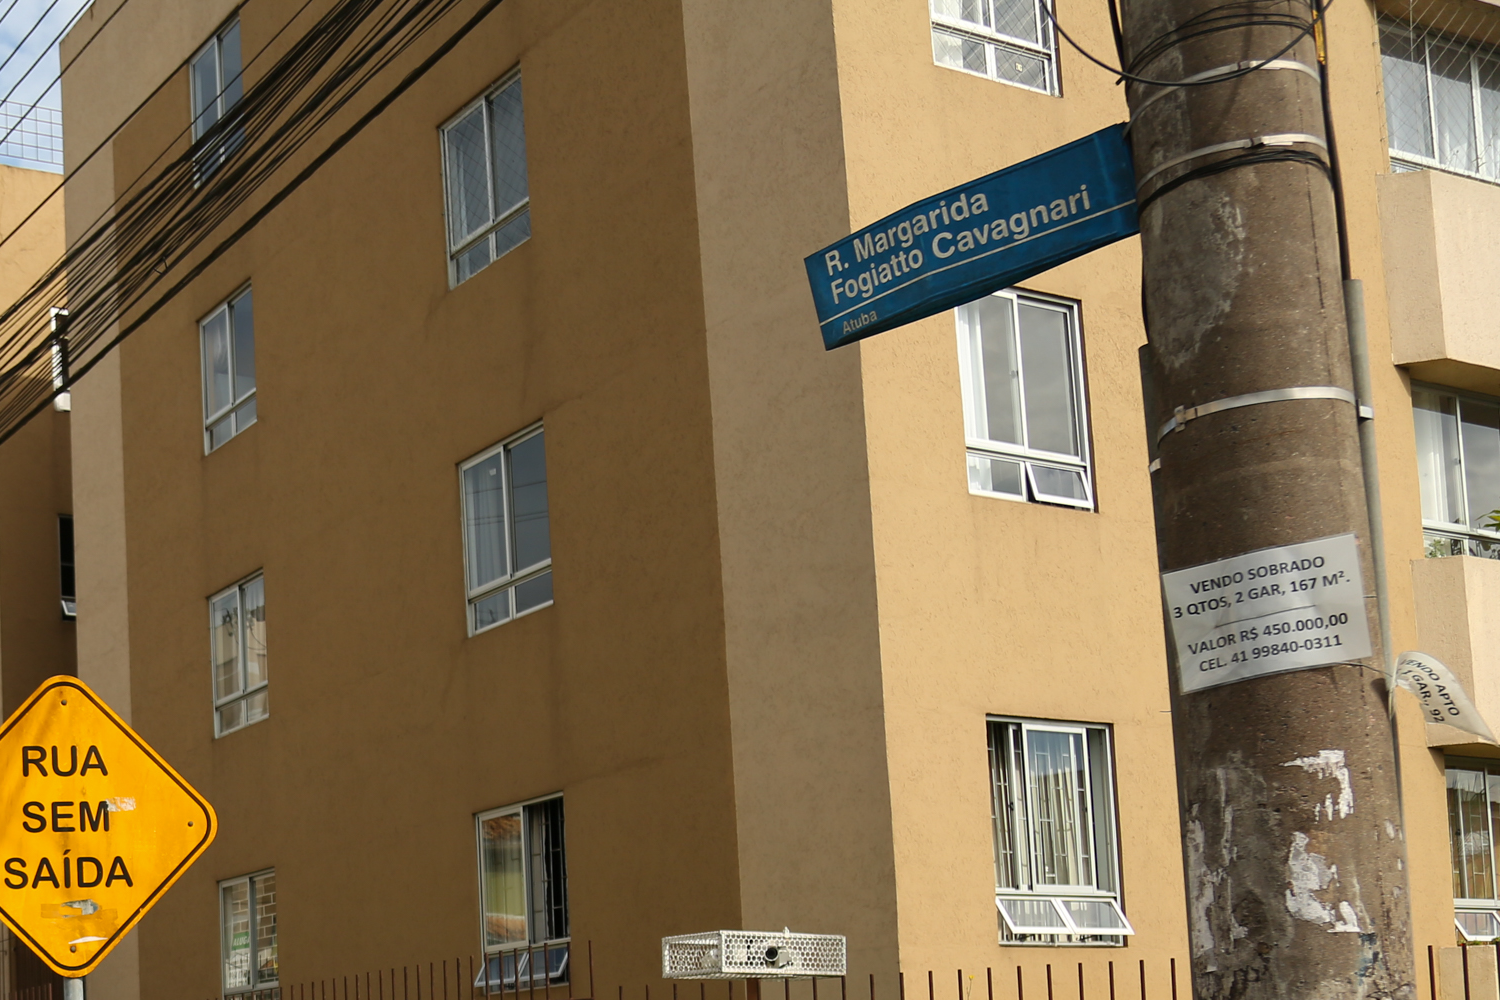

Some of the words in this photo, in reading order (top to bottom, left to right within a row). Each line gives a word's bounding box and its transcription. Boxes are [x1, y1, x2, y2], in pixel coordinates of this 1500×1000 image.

[824, 249, 849, 277] R.
[852, 193, 989, 263] Margarida
[830, 248, 923, 305] Fogiatto
[931, 184, 1092, 259] Cavagnari
[842, 309, 878, 335] Atuba
[1190, 571, 1244, 595] VENDO
[1247, 556, 1325, 581] SOBRADO
[1173, 607, 1183, 619] 3
[1186, 595, 1232, 616] QTOS,
[1234, 591, 1245, 604] 2
[1247, 584, 1286, 601] GAR,
[1290, 578, 1318, 593] 167
[1188, 633, 1237, 655] VALOR
[1240, 627, 1259, 643] R$
[1262, 612, 1349, 638] 450.000,00
[1199, 657, 1228, 672] CEL.
[1231, 649, 1249, 664] 41
[1252, 634, 1343, 660] 99840-0311
[1435, 684, 1460, 717] APTO
[21, 745, 108, 777] RUA
[22, 801, 110, 833] SEM
[3, 849, 134, 889] SAÍDA
